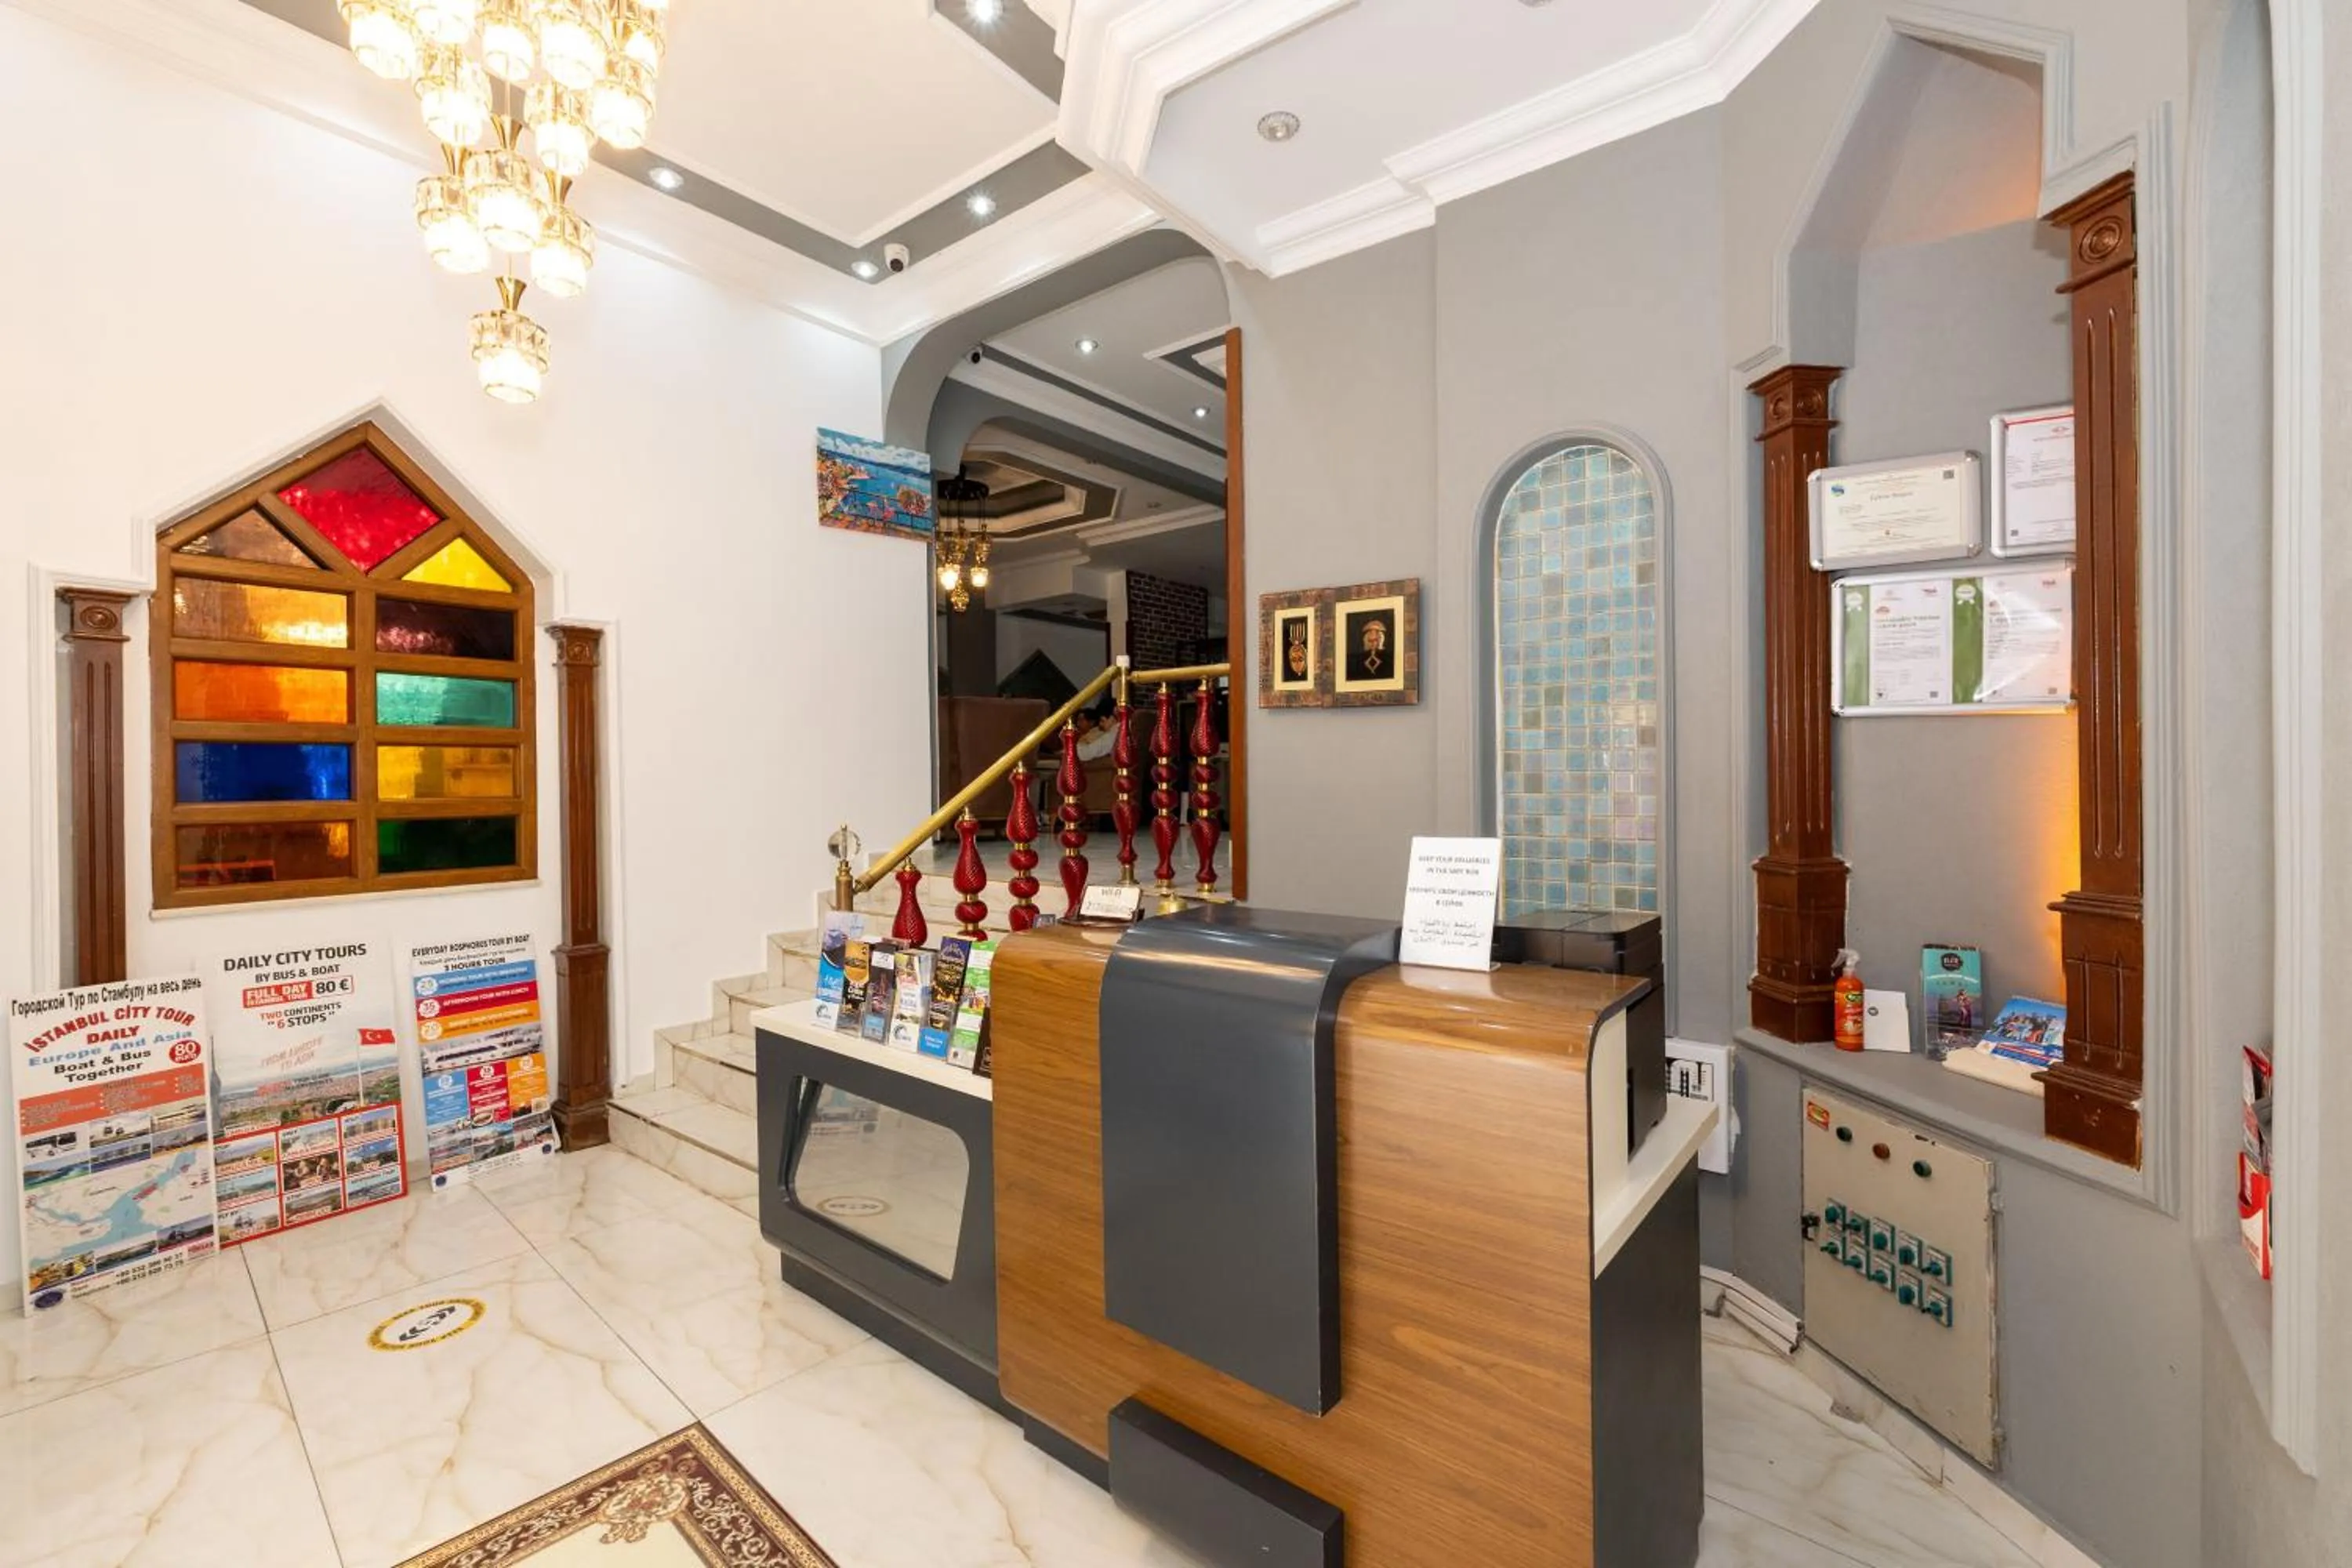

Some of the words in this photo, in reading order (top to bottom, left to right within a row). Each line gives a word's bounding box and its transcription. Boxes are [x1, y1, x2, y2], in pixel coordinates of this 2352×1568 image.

[412, 944, 448, 956] EVERYDAY
[489, 937, 504, 947] TOUR
[515, 934, 529, 943] BOAT
[223, 954, 272, 971] DAILY
[275, 949, 311, 965] CITY
[314, 943, 367, 960] TOURS
[452, 961, 481, 971] HOURS
[484, 957, 505, 967] TOUR
[255, 972, 270, 983] BY
[272, 969, 296, 981] BUS
[298, 968, 307, 978] &
[311, 964, 341, 976] BOAT
[12, 993, 65, 1017] Городской
[68, 992, 85, 1010] Тур
[87, 993, 100, 1004] по
[101, 985, 145, 1003] Стамбулу
[147, 983, 158, 995] на
[160, 981, 180, 993] весь
[181, 978, 201, 990] день
[246, 986, 278, 1000] FULL
[282, 983, 307, 996] DAY
[315, 980, 336, 994] 80
[339, 978, 350, 991] €
[155, 1007, 195, 1026] TOUR
[260, 1011, 282, 1020] TWO
[283, 1002, 342, 1017] CONTINENTS
[277, 1018, 285, 1029] 6
[287, 1013, 327, 1029] STOPS
[86, 1025, 140, 1044] DAILY
[27, 1047, 102, 1067] Europe
[109, 1038, 147, 1052] And
[153, 1030, 192, 1044] Asia
[53, 1060, 96, 1075] Boat
[102, 1054, 114, 1065] &
[120, 1049, 151, 1062] Bus
[174, 1042, 196, 1056] 80
[64, 1062, 143, 1083] Together
